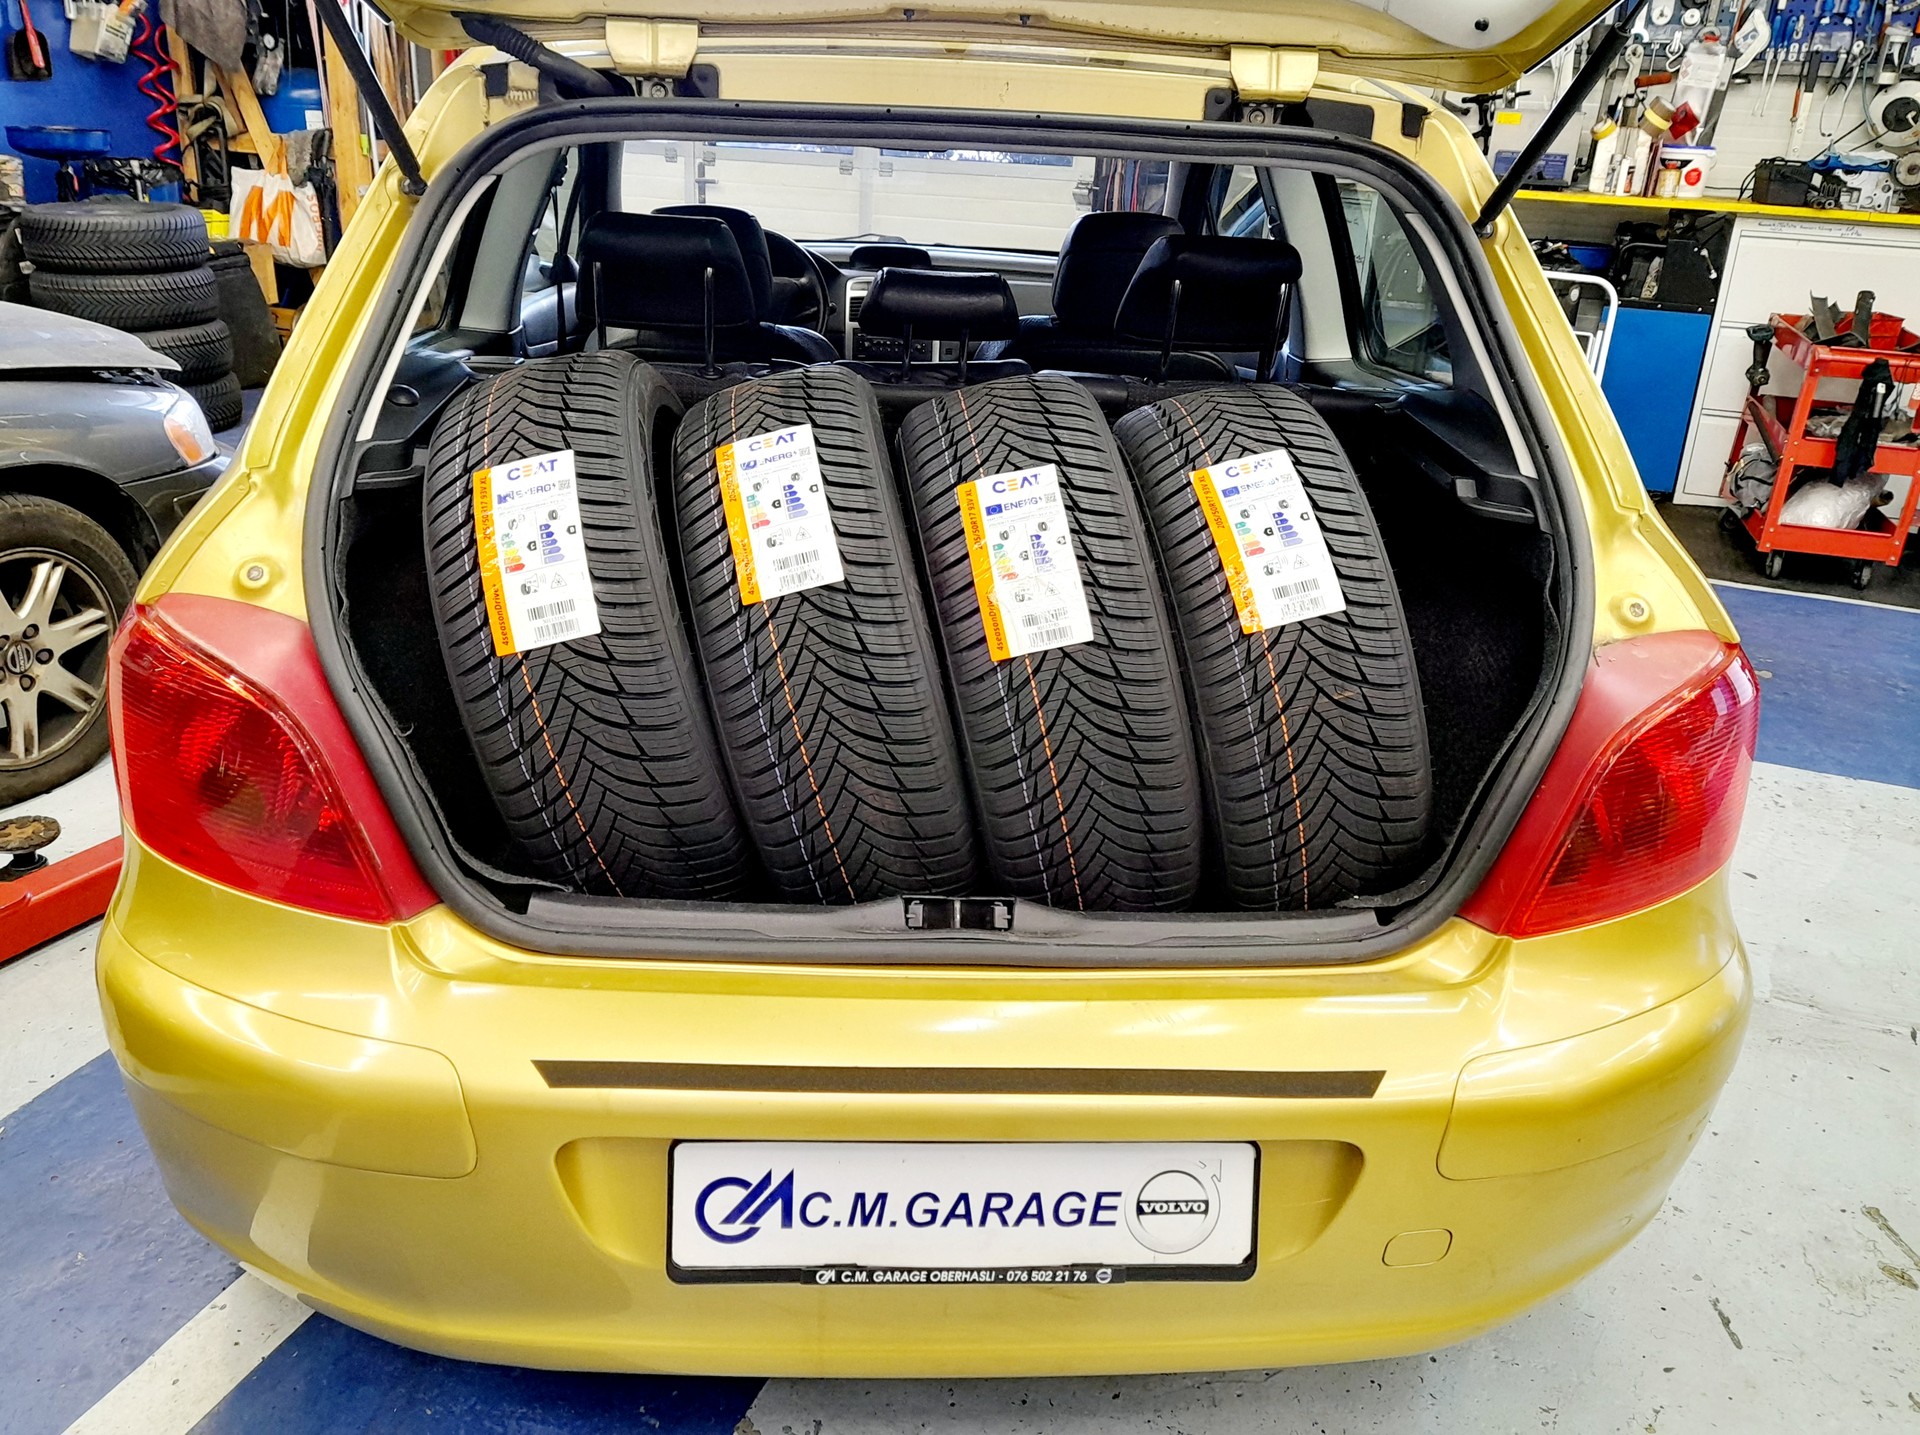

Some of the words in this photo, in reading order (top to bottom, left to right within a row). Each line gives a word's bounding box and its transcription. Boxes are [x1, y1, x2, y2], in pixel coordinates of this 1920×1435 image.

[748, 431, 797, 452] CEAT
[506, 458, 558, 481] CEAT
[1225, 457, 1274, 478] CEAT
[992, 473, 1041, 494] CEAT
[1139, 1201, 1206, 1214] VOLVO
[840, 1271, 870, 1283] C.M.
[872, 1271, 928, 1283] GARAGE
[929, 1271, 995, 1282] OBERHASLI
[1006, 1270, 1029, 1282] 076
[1031, 1270, 1052, 1282] 502
[1055, 1270, 1069, 1281] 21
[1073, 1270, 1088, 1282] 76
